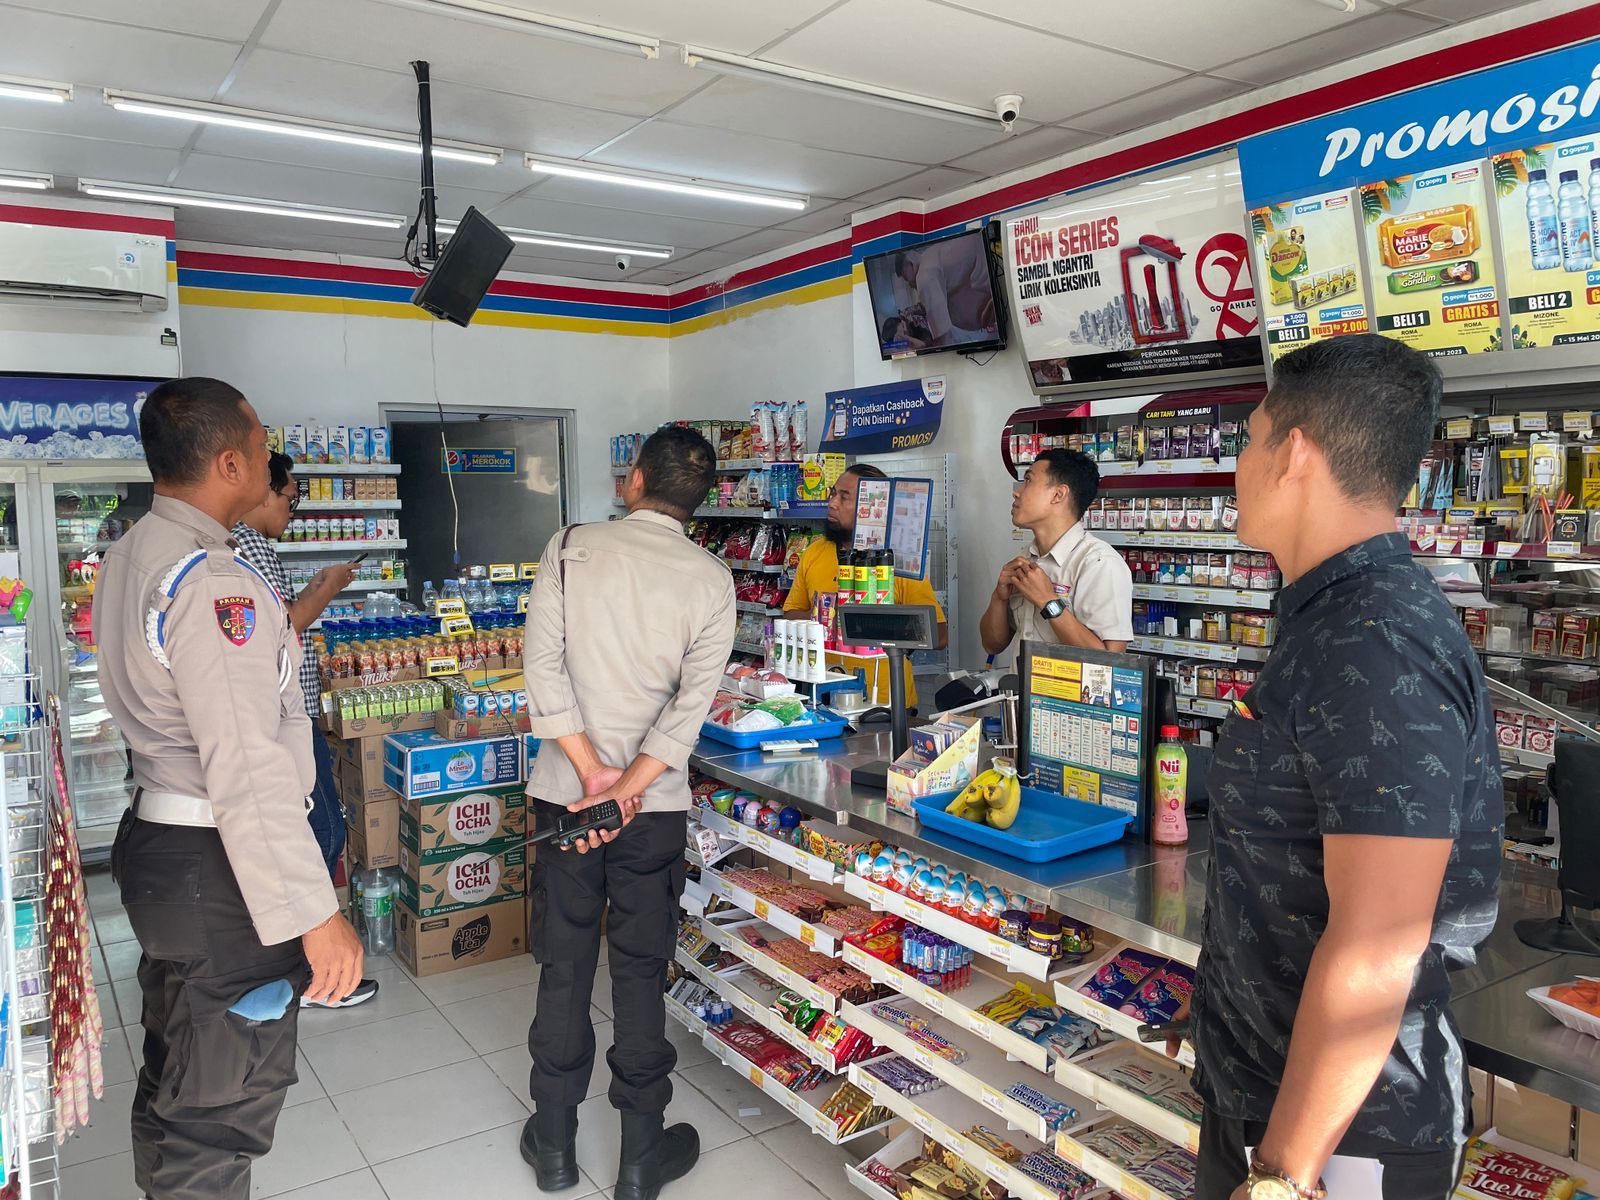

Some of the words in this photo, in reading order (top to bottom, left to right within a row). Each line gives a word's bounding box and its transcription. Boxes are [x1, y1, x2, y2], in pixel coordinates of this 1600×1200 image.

[1014, 216, 1039, 237] BARU!
[1015, 231, 1053, 266] ICON
[1058, 216, 1119, 257] SERIES
[1395, 234, 1429, 246] MARIE
[1397, 242, 1429, 254] GOLD
[1271, 250, 1300, 263] Dancow
[1017, 262, 1051, 283] SAMBIL
[1053, 253, 1094, 276] NGANTRI
[1408, 271, 1426, 280] Sari
[1020, 281, 1043, 300] LIRIK
[1044, 270, 1101, 296] KOLEKSINYA
[1401, 275, 1436, 287] Gandum
[1210, 305, 1221, 313] GO
[1229, 300, 1257, 310] AHEAD
[1528, 294, 1556, 310] BELI
[1558, 293, 1567, 307] 2
[1446, 304, 1489, 321] GRATIS
[1491, 303, 1499, 315] 1
[1393, 314, 1416, 328] BELI
[1418, 312, 1424, 324] 1
[1278, 329, 1298, 341] BELI
[1299, 327, 1305, 339] 1
[1312, 326, 1332, 335] TEBUS
[1342, 321, 1368, 333] 2.000
[852, 403, 885, 416] Dapatkan
[886, 398, 925, 411] Cashback
[1146, 411, 1160, 419] CARI
[1160, 410, 1175, 418] TAHU
[1177, 408, 1194, 417] YANG
[1194, 407, 1211, 415] BARU
[852, 417, 871, 427] POIN
[872, 414, 895, 425] Disini!
[892, 432, 934, 449] PROMOSI
[1034, 659, 1053, 668] GRATIS
[363, 672, 391, 686] Milk
[456, 802, 490, 820] ICHI
[456, 816, 491, 831] OCHA
[456, 862, 490, 879] ICHI
[455, 875, 491, 890] OCHA
[454, 924, 488, 941] Apple
[460, 939, 480, 951] Tea
[782, 991, 801, 1002] MILO
[922, 1028, 949, 1046] mentos
[1013, 1088, 1048, 1111] mentos
[1026, 1158, 1068, 1180] mentos
[1022, 1168, 1058, 1189] mentos
